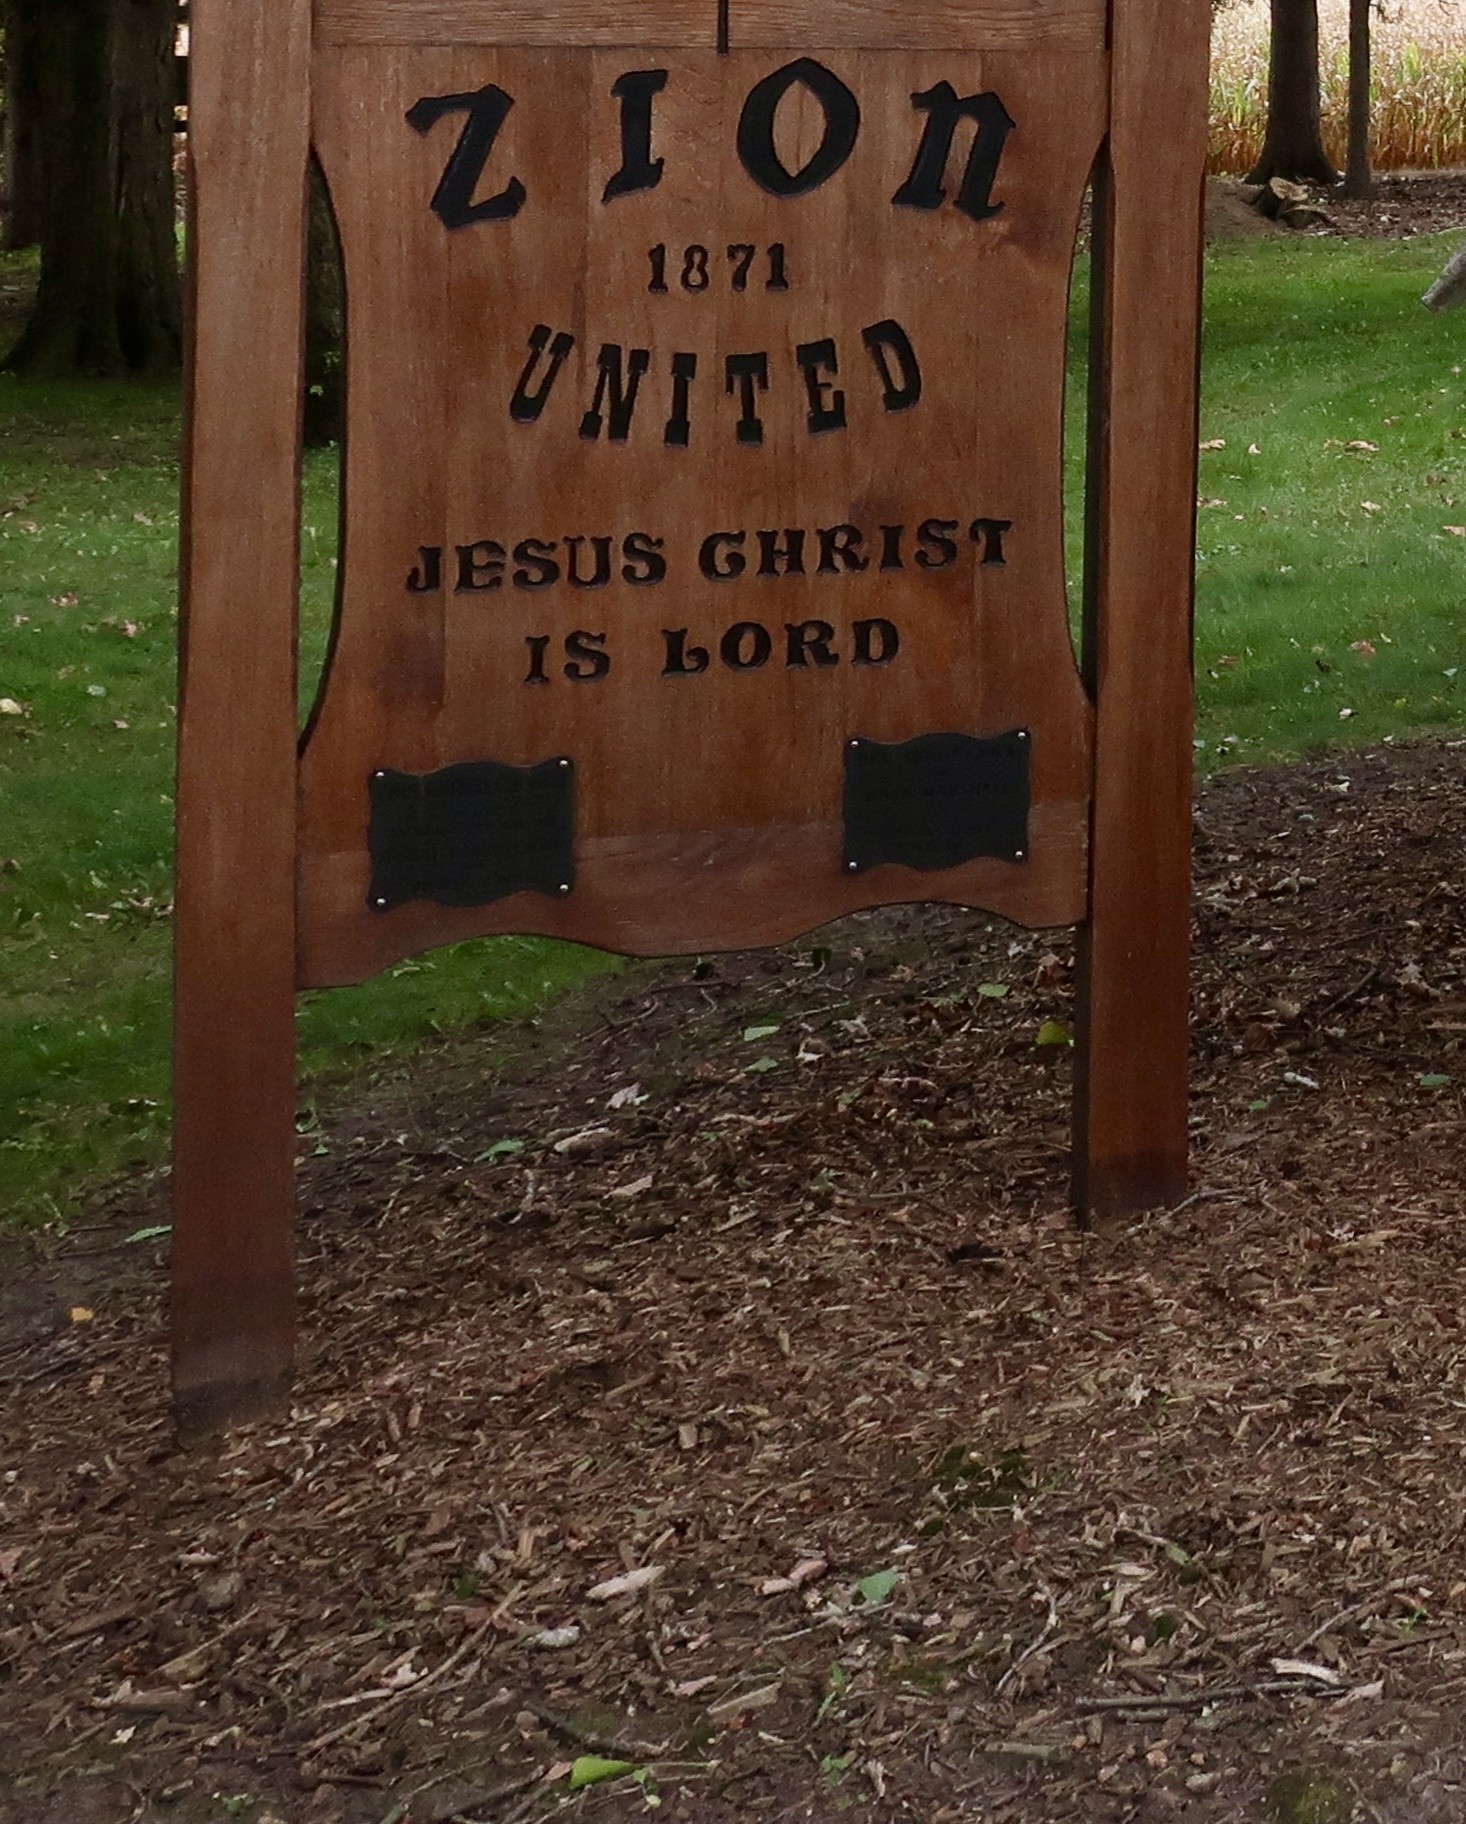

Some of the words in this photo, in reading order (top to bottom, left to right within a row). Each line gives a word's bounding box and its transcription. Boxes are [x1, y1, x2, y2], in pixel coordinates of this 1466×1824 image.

[648, 242, 790, 294] 1871
[509, 319, 922, 447] UNITED
[406, 532, 667, 595] JESUS
[698, 517, 1013, 578] CHRIST
[524, 631, 611, 685] IS
[660, 618, 900, 679] LORD
